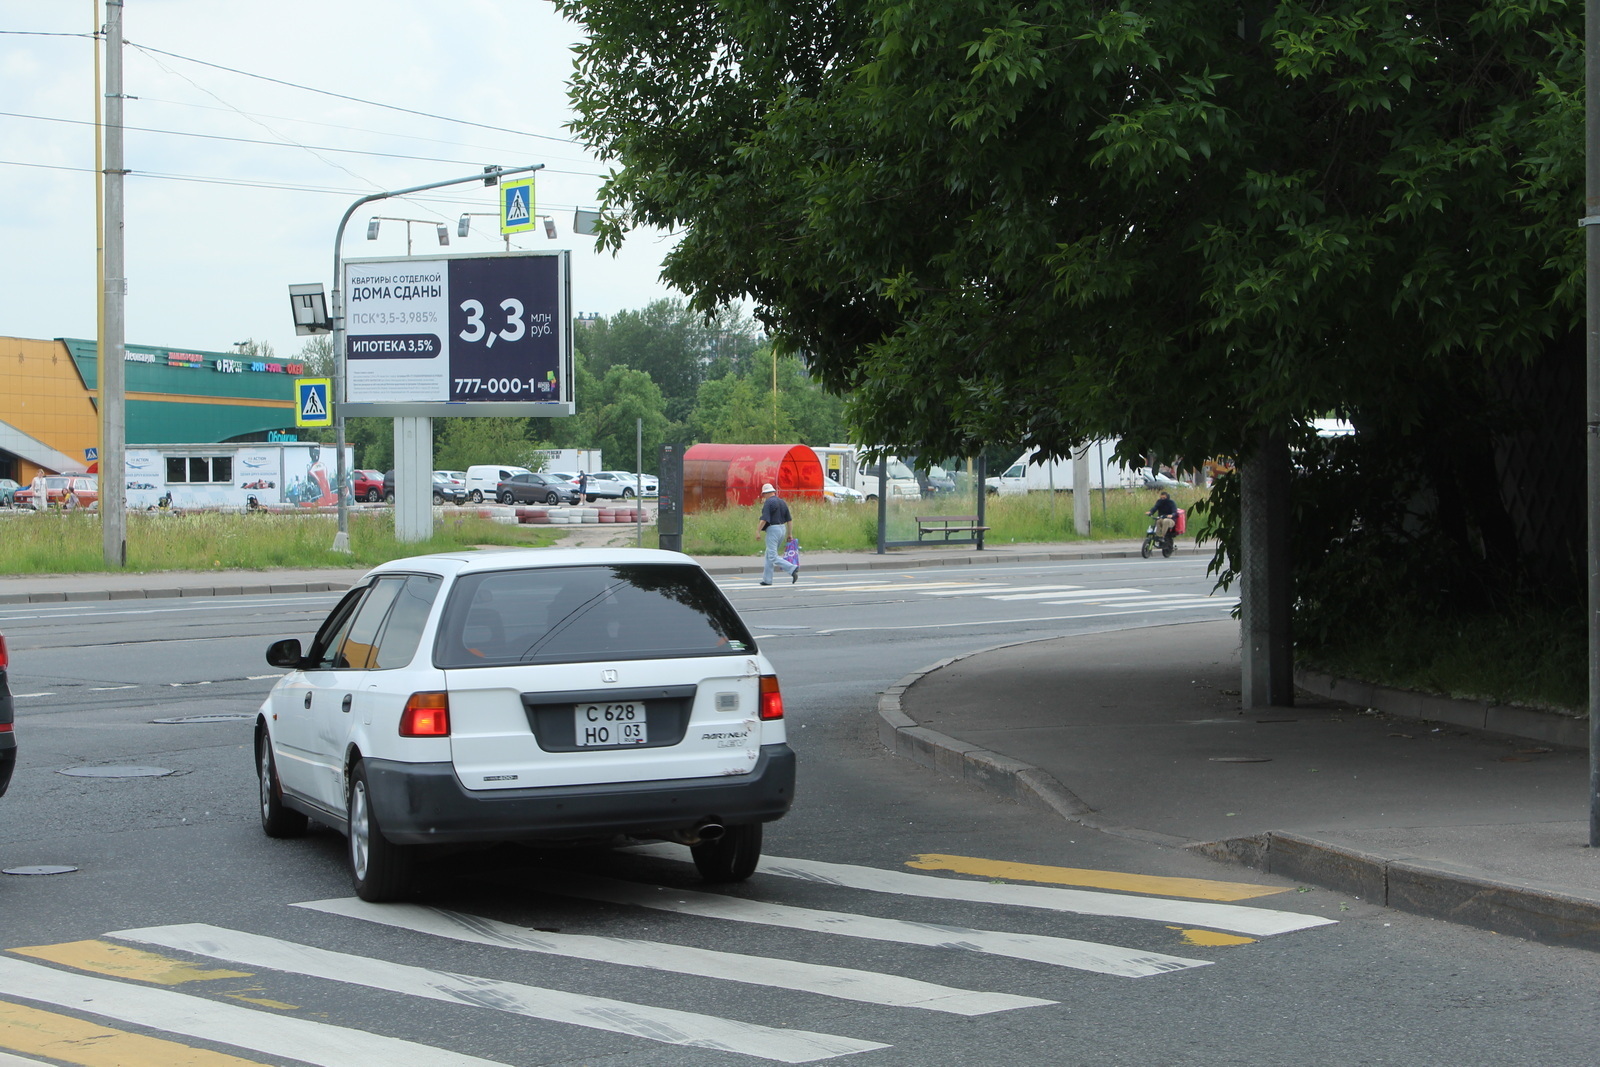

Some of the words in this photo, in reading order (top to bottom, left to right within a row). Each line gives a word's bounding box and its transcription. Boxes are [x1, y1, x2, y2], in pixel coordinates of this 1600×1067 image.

[351, 275, 391, 285] КВАРТИРЫ
[392, 275, 398, 283] С
[399, 272, 441, 284] ОТДЕЛКОЙ
[352, 286, 391, 302] ДОМА
[393, 285, 442, 301] СДАНЫ
[458, 297, 526, 349] 3,3
[530, 313, 552, 322] млн
[530, 322, 553, 337] руб.
[352, 339, 407, 353] ИПОТЕКА
[408, 339, 434, 354] 3,5%
[454, 377, 535, 394] 777-000-1
[586, 706, 598, 722] С
[604, 704, 635, 721] 628
[585, 726, 609, 743] НО
[624, 722, 641, 737] 03
[701, 731, 748, 740] PARTNER
[717, 738, 747, 748] LEV
